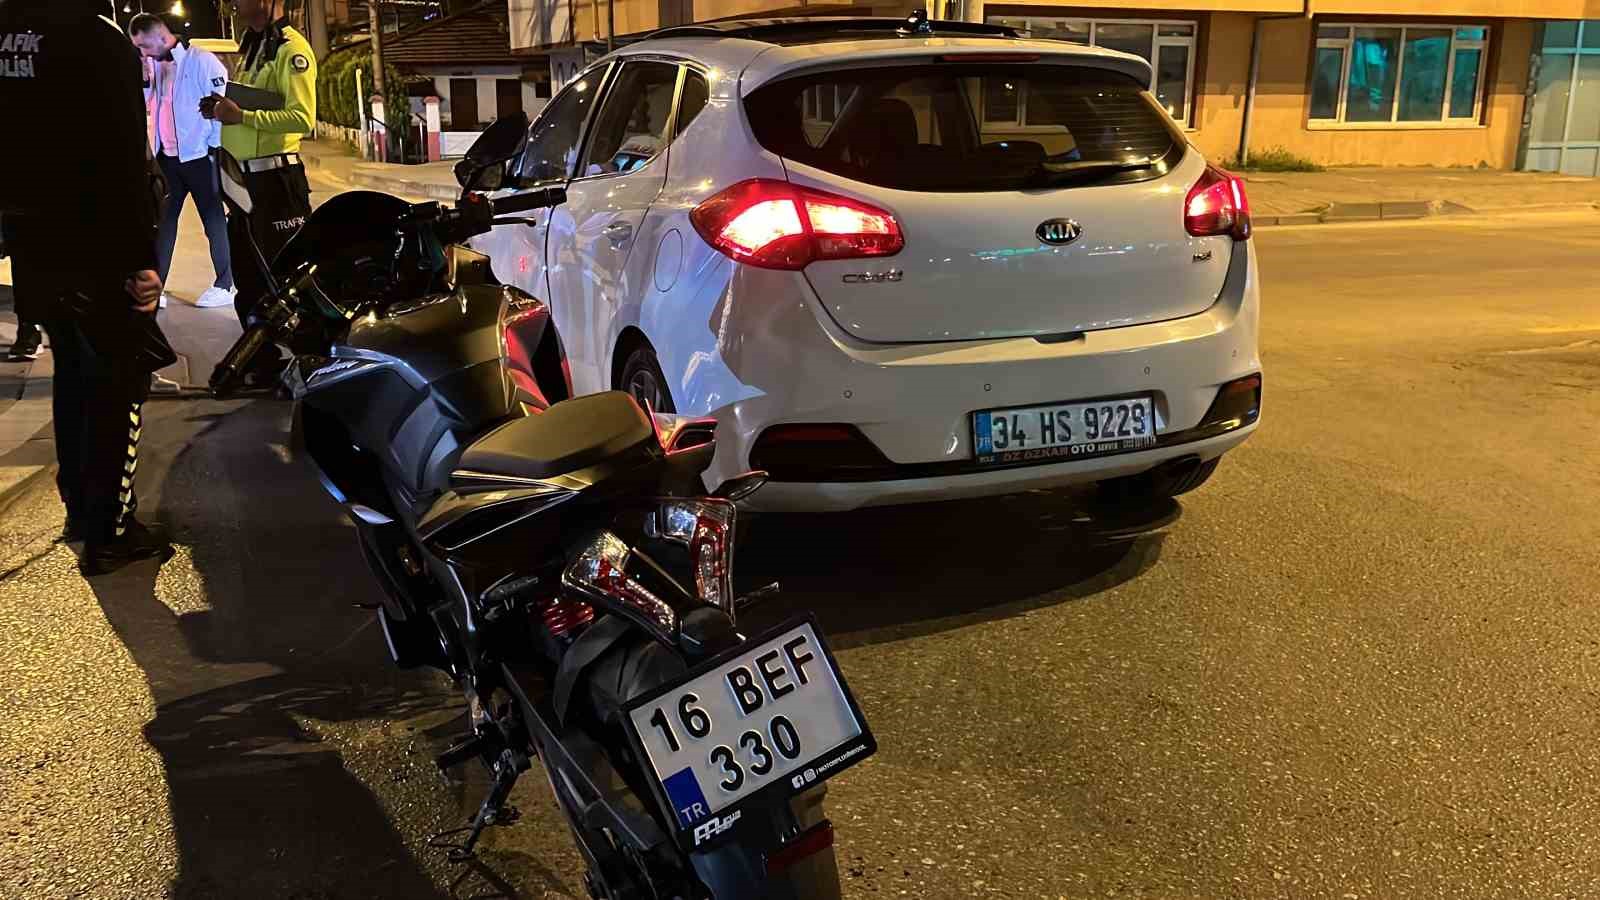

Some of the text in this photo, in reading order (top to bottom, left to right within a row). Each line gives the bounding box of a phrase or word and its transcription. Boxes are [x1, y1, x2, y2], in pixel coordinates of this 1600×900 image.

[0, 30, 44, 52] AFİK
[1044, 223, 1077, 240] KIA
[993, 402, 1146, 449] 34 HS 9229
[1071, 443, 1096, 455] OTO
[650, 634, 815, 753] 16 BEF
[710, 715, 802, 792] 330
[680, 802, 706, 823] TR
